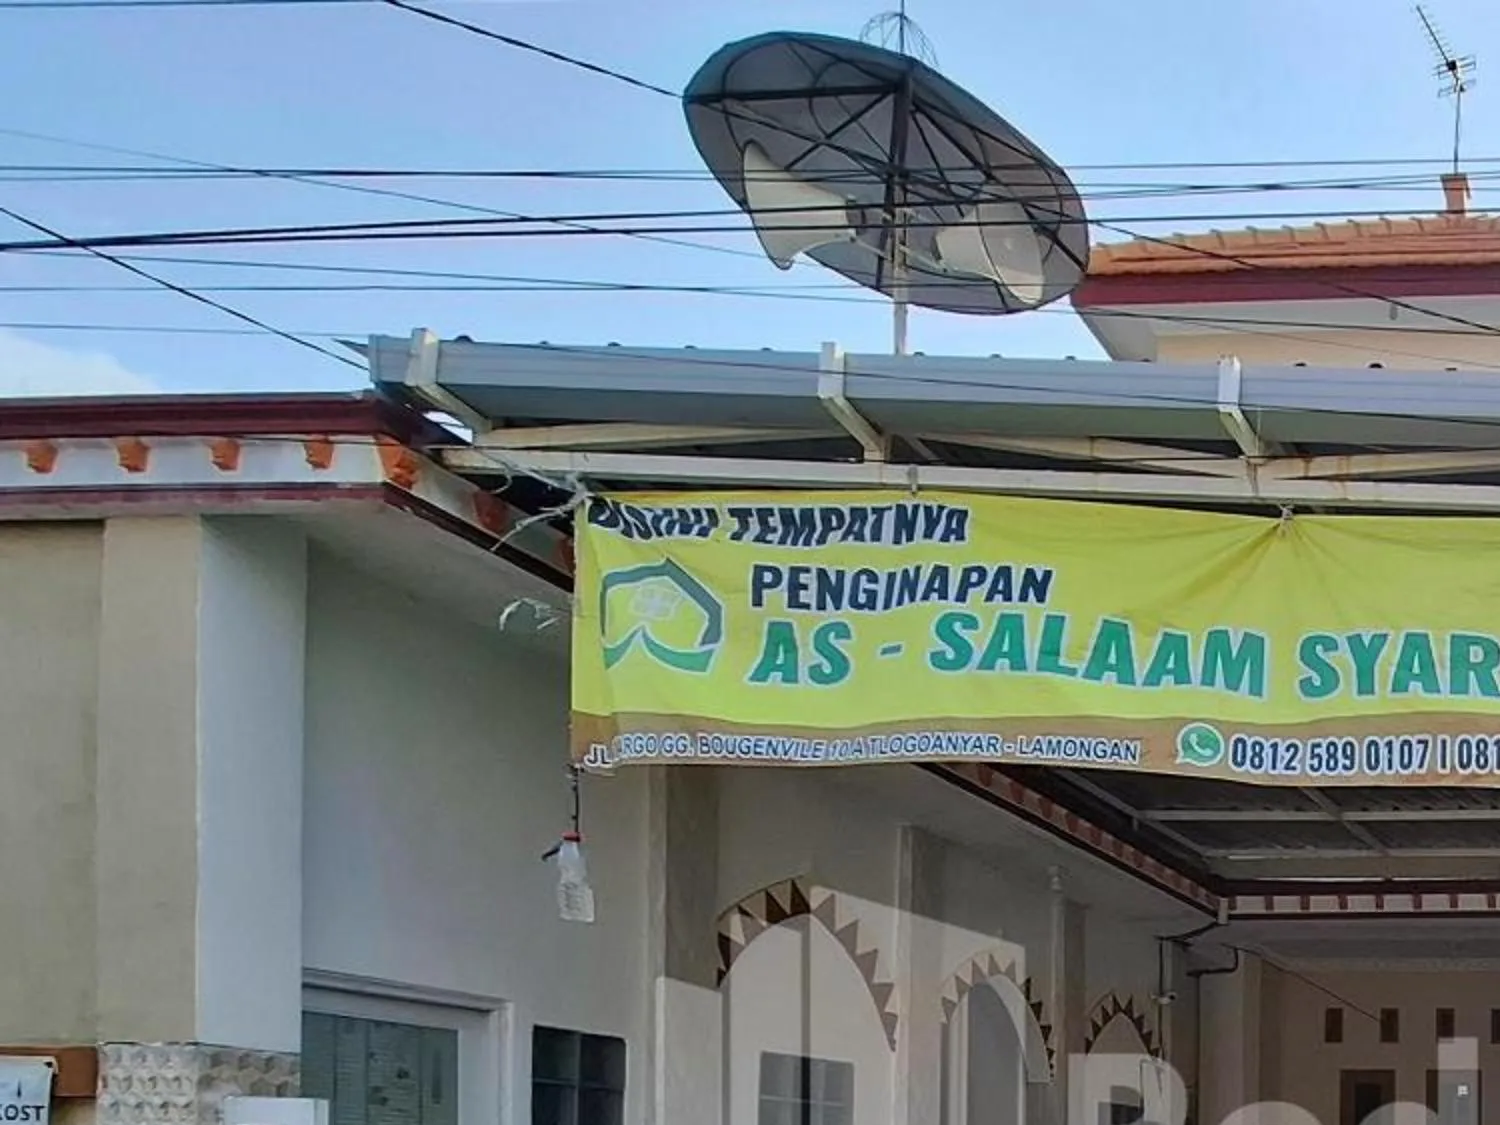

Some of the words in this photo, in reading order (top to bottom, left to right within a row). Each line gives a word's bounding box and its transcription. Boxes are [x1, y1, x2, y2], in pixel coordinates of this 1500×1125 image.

[727, 503, 969, 547] TEMPATNYA
[751, 563, 1054, 612] PENGINAPAN
[748, 619, 852, 686] AS
[928, 611, 1266, 699] SALAAM
[699, 734, 825, 759] BOUGENVILE
[868, 734, 1001, 756] TLOGOANYAR
[1018, 736, 1140, 762] LAMONGAN
[1231, 736, 1299, 773] 0812
[1308, 736, 1356, 773] 589
[1365, 736, 1428, 773] 0107
[0, 1104, 46, 1122] OST
